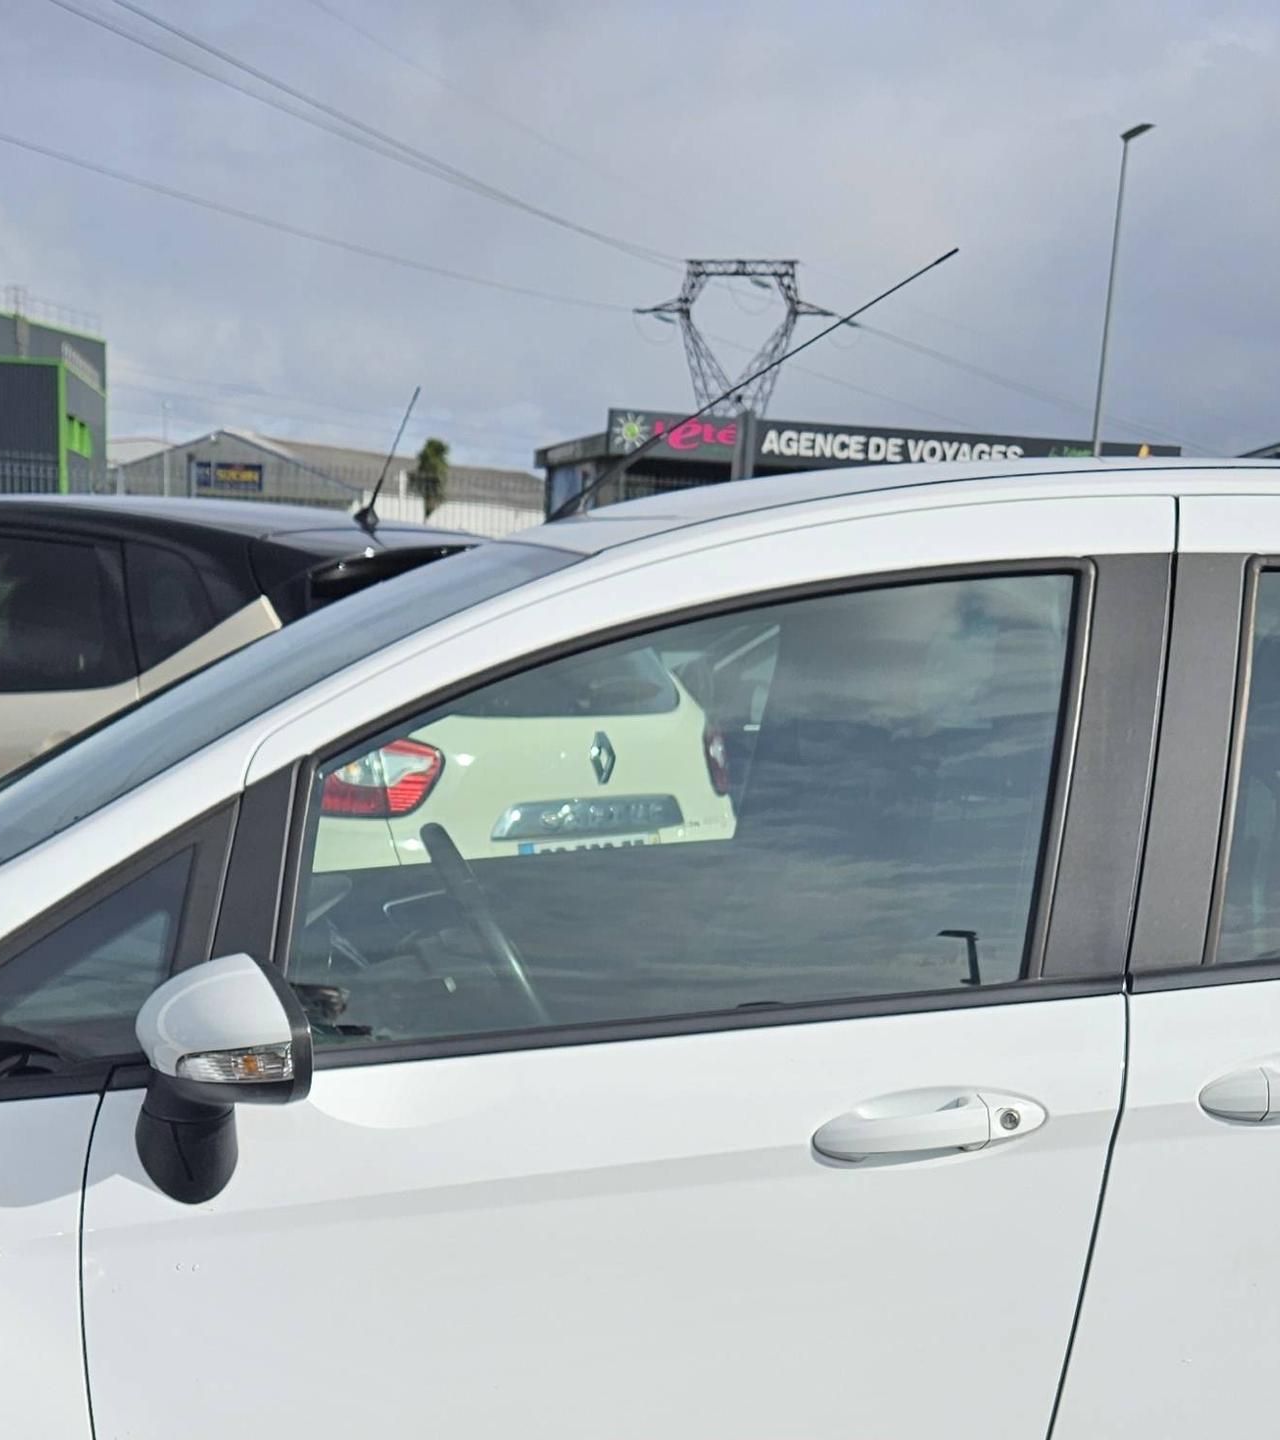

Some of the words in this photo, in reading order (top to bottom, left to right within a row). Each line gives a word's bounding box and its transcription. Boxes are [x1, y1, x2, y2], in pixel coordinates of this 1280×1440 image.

[761, 429, 867, 461] AGENCE
[868, 437, 903, 462] DE
[907, 439, 1024, 464] VOYAGES
